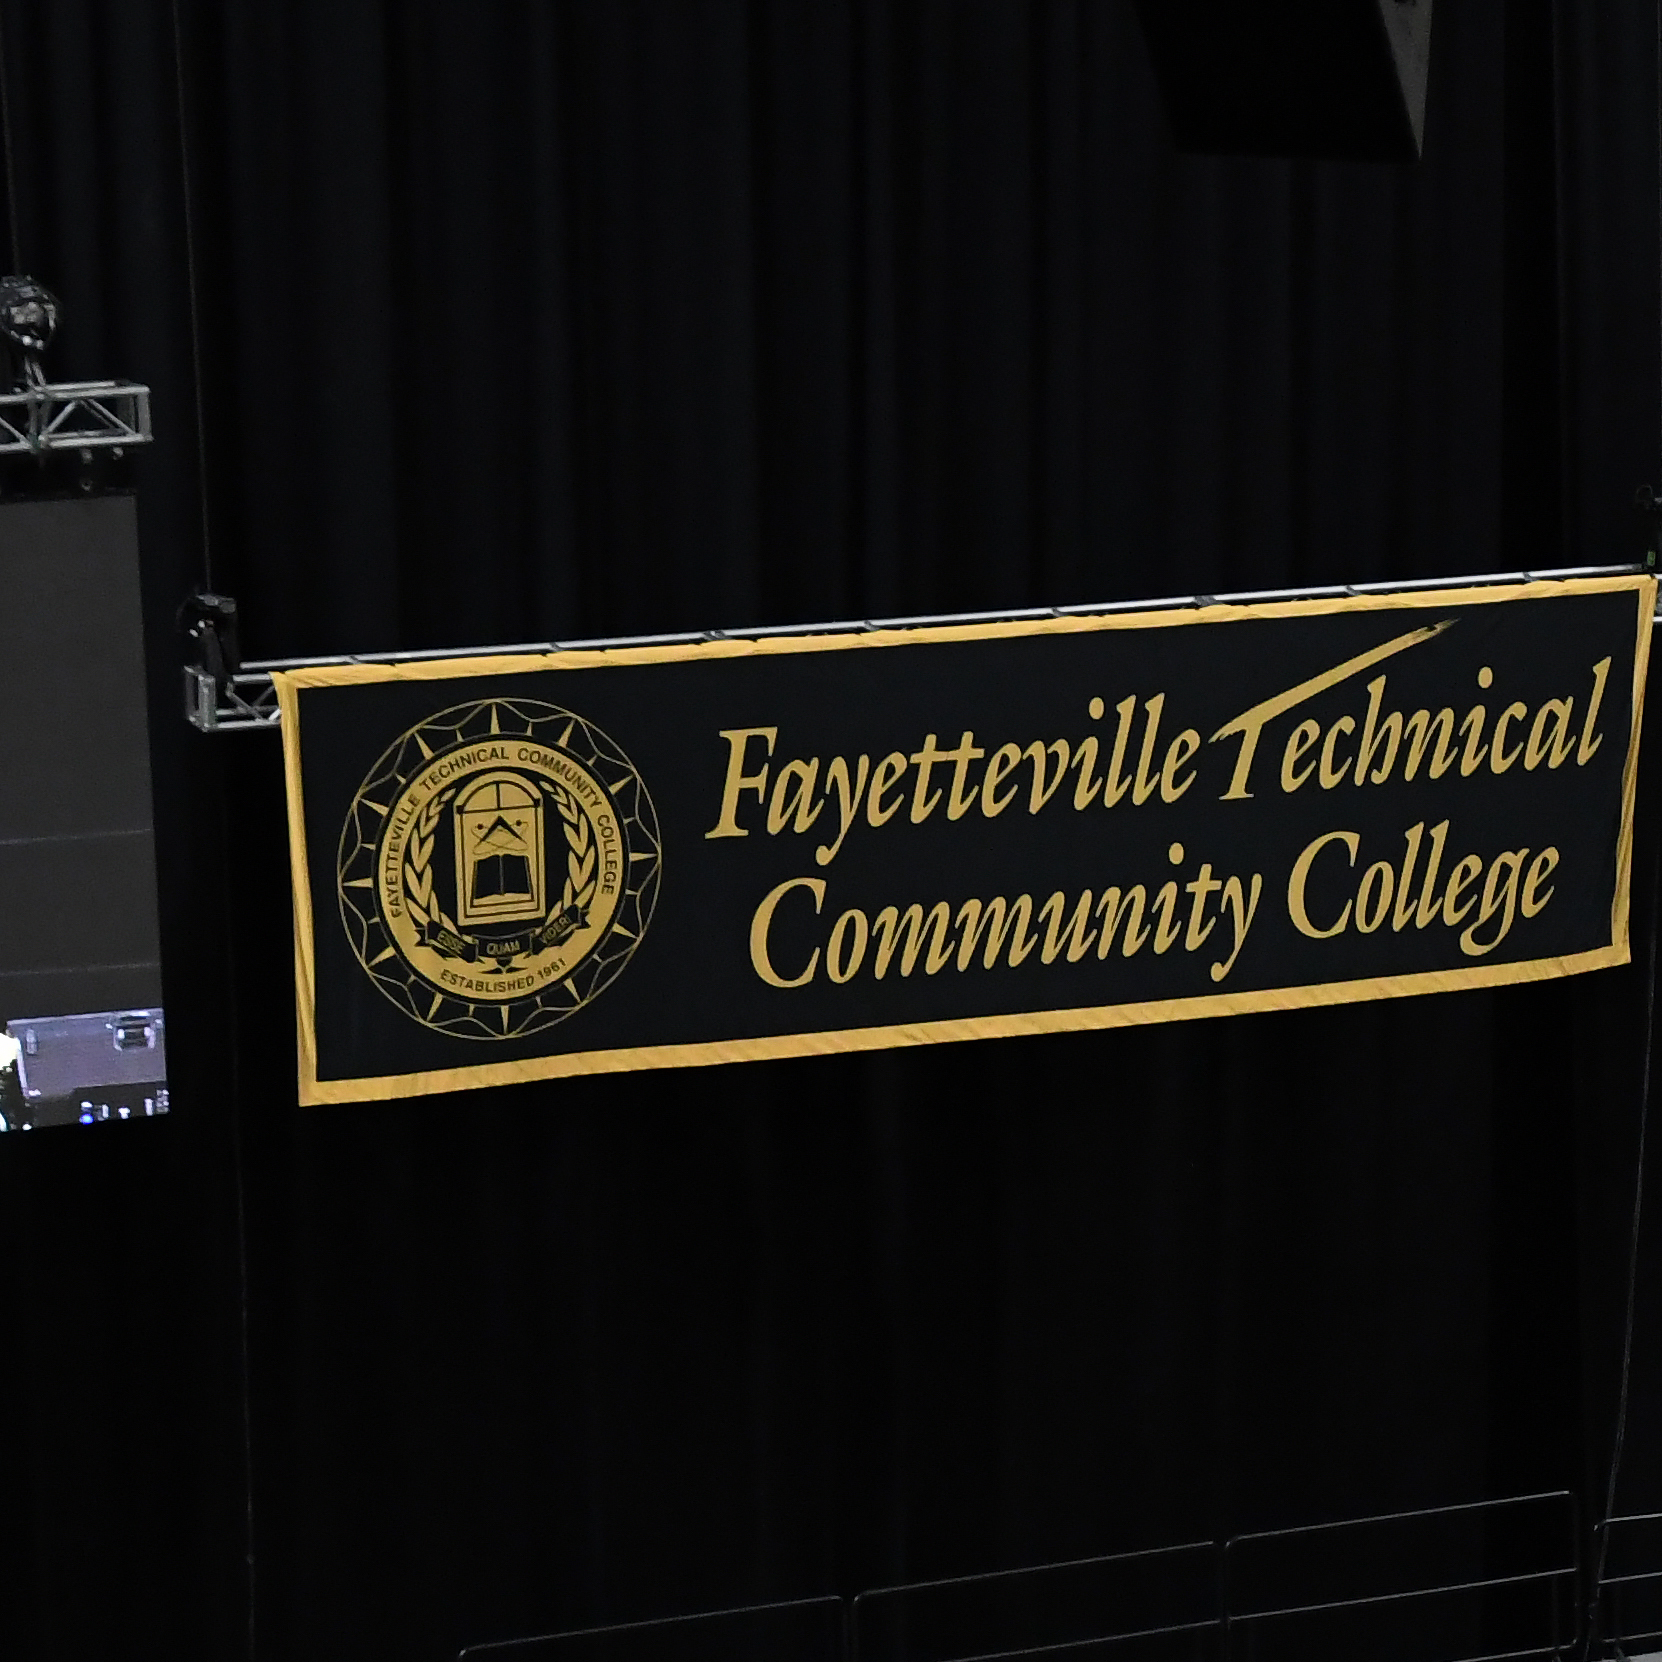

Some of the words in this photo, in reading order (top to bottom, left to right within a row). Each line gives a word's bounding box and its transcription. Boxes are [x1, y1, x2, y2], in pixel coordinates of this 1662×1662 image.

[704, 692, 1200, 866] Fayetteville
[1208, 617, 1612, 801] Technical
[384, 794, 421, 918] FAYETTEVILLE
[419, 747, 510, 791] TECHNICAL
[517, 747, 603, 809] COMMUNITY
[597, 813, 618, 895] COLLEGE
[750, 842, 1262, 988] Community
[1288, 819, 1559, 957] College
[440, 969, 535, 993] ESTABLISHED
[537, 957, 567, 979] 1961
